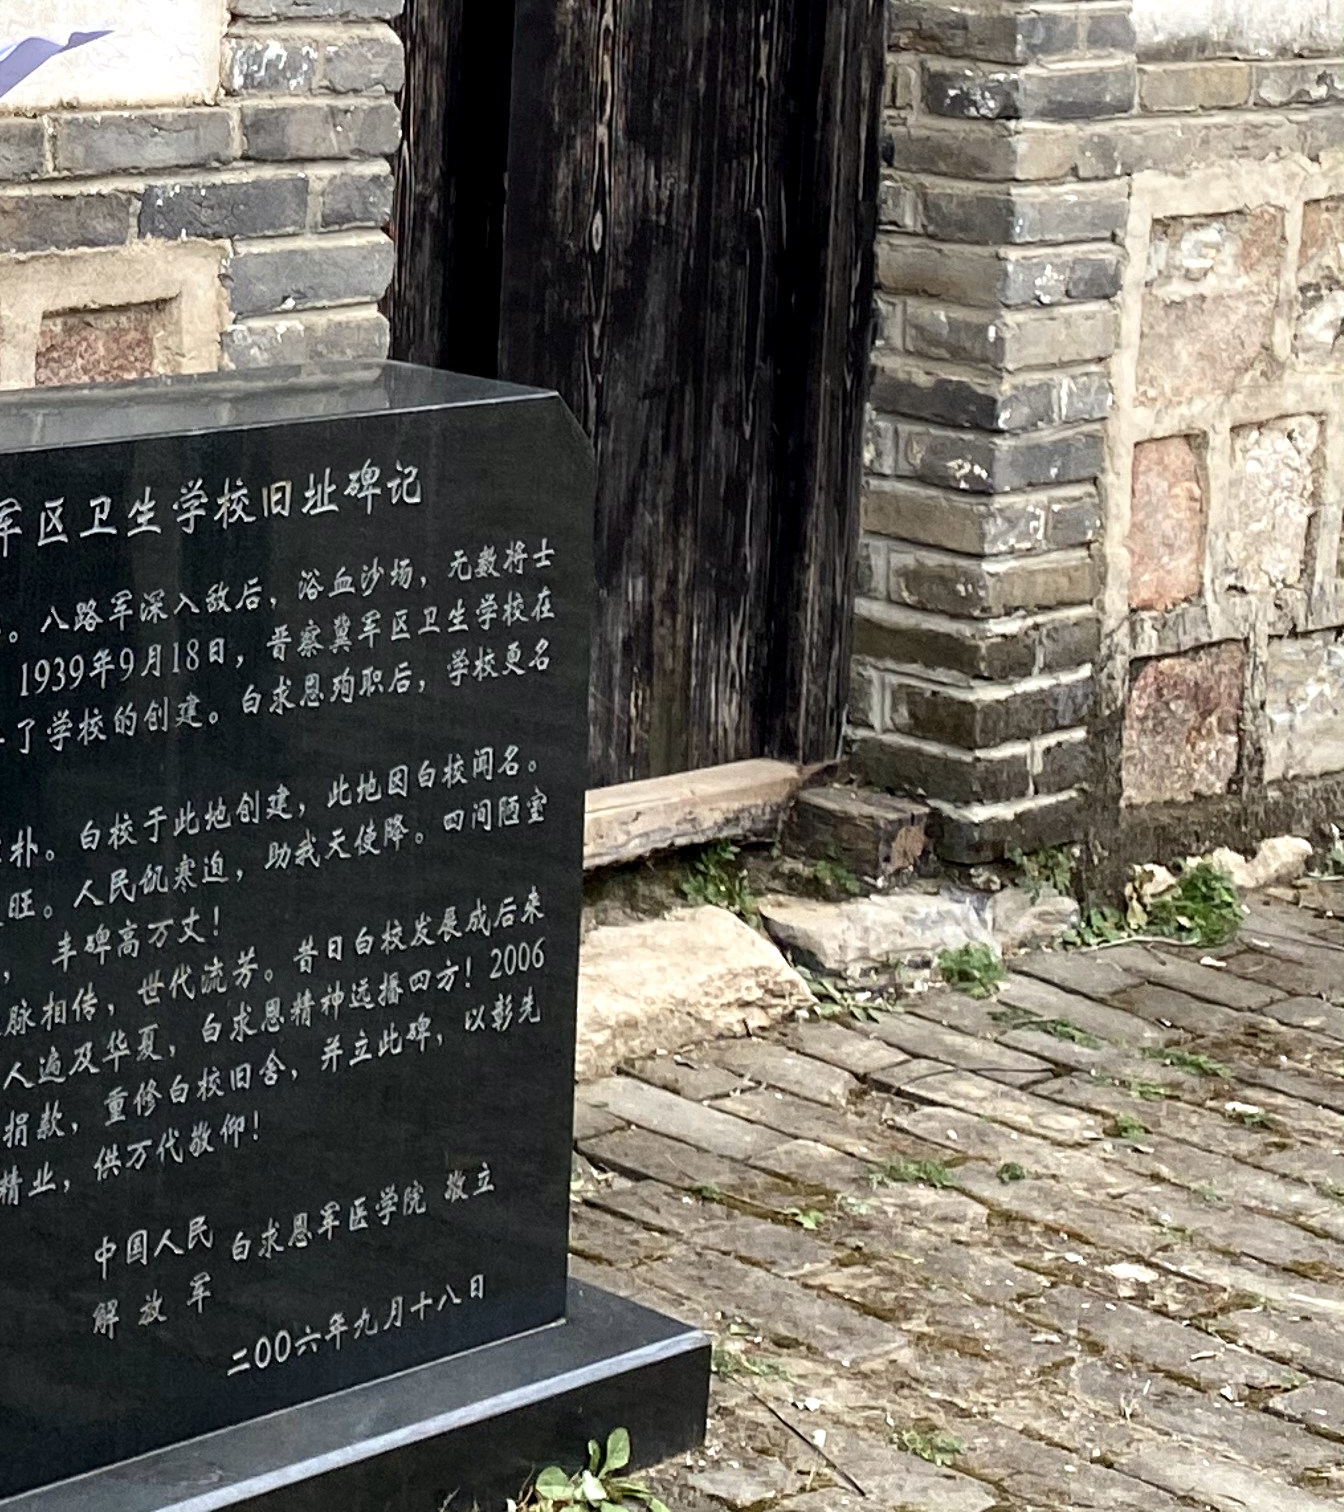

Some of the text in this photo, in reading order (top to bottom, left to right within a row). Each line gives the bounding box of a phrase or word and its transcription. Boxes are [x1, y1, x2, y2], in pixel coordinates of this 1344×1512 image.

[93, 1214, 214, 1282] 中国人民
[230, 1178, 428, 1262] 白求恩军医学院
